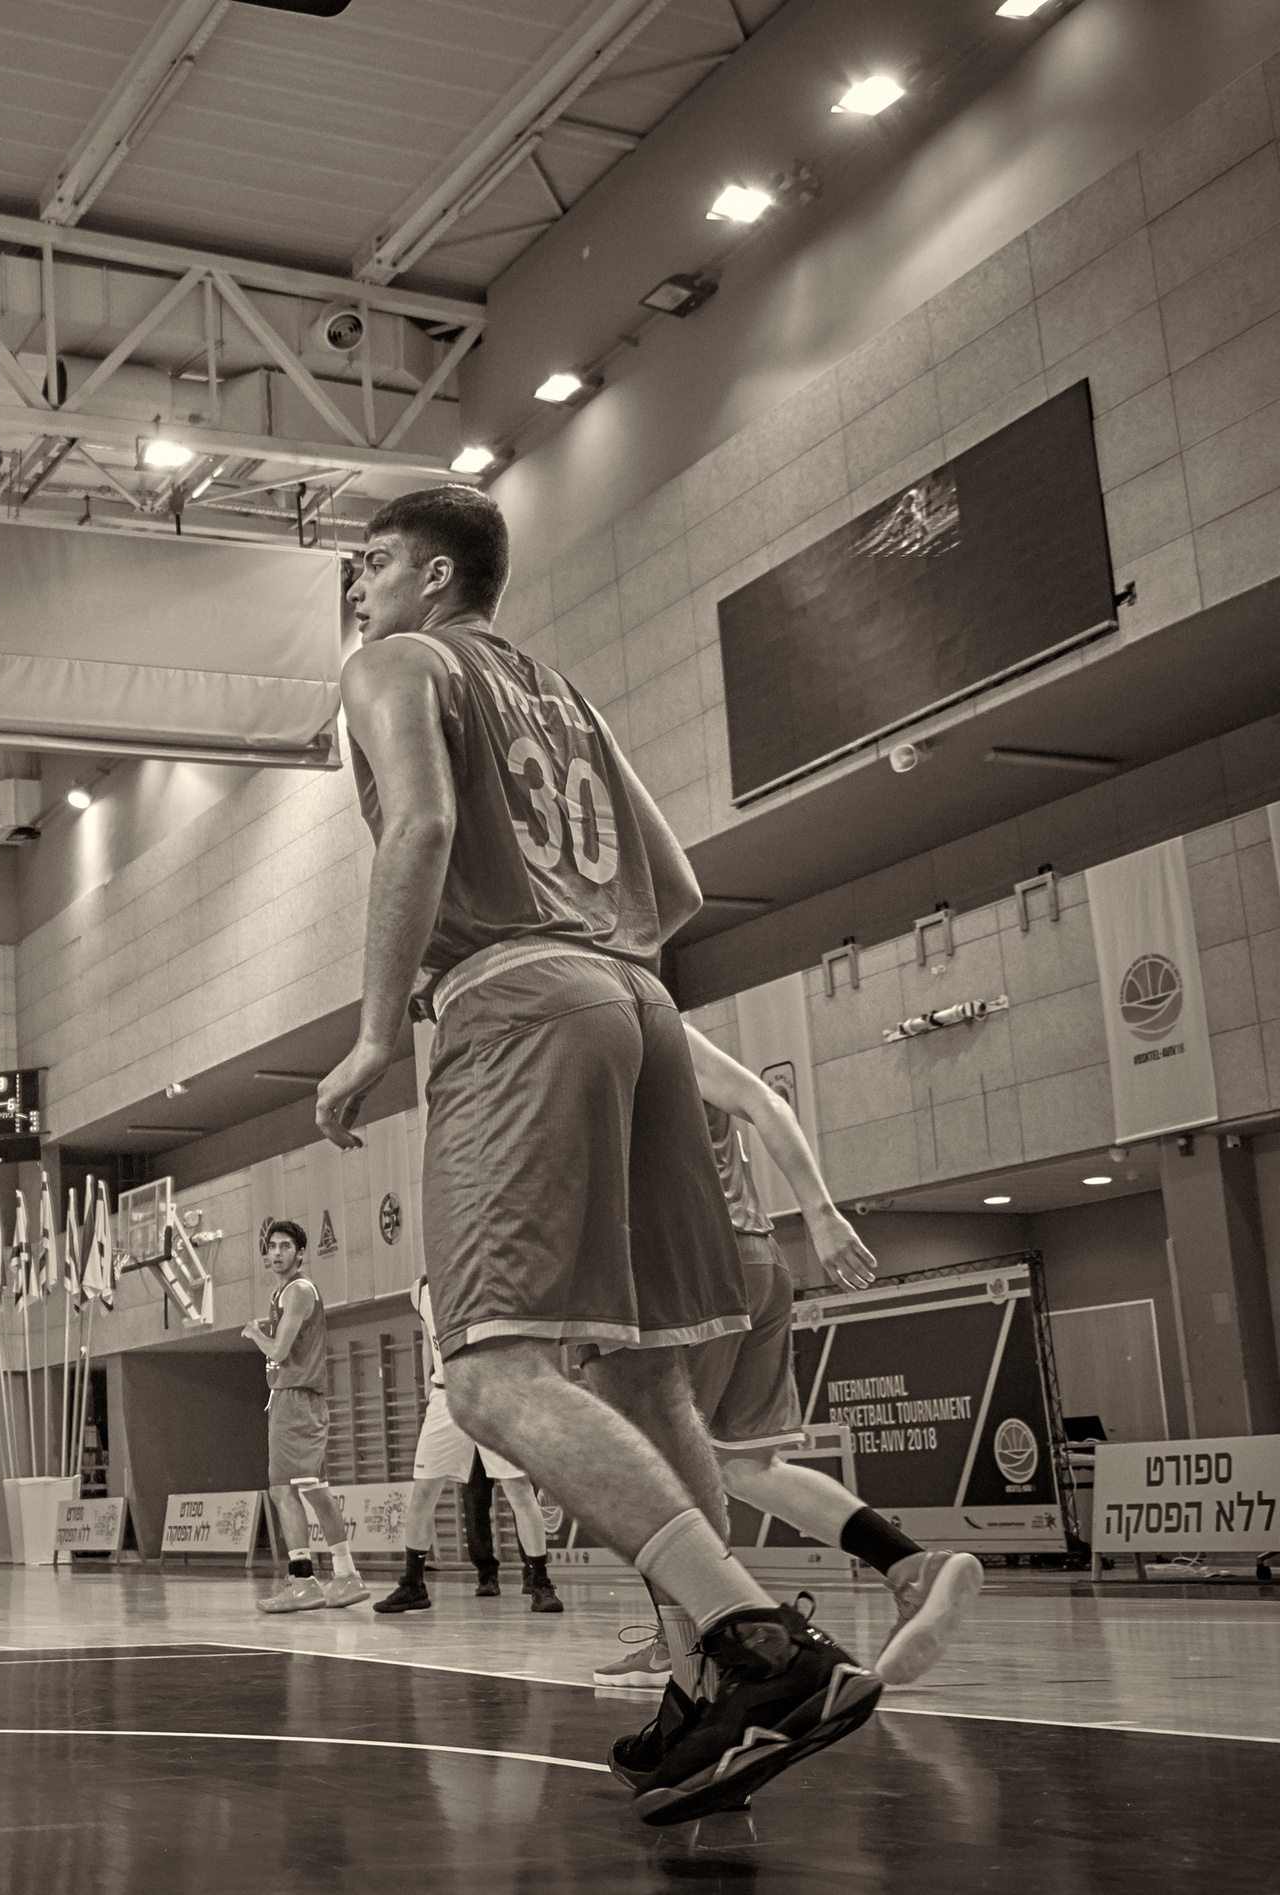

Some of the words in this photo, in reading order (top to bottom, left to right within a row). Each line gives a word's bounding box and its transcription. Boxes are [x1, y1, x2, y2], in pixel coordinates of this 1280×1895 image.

[508, 737, 617, 885] 30
[827, 1374, 909, 1403] INTERNATIONAL
[829, 1403, 896, 1428] BASKETBALL
[895, 1396, 971, 1424] TOURNAMENT
[857, 1429, 905, 1454] TEL-AVIV
[907, 1427, 938, 1450] 2018
[1146, 1452, 1232, 1487] ספורט
[1105, 1501, 1202, 1542] הפסקה
[1215, 1490, 1276, 1532] ללא
